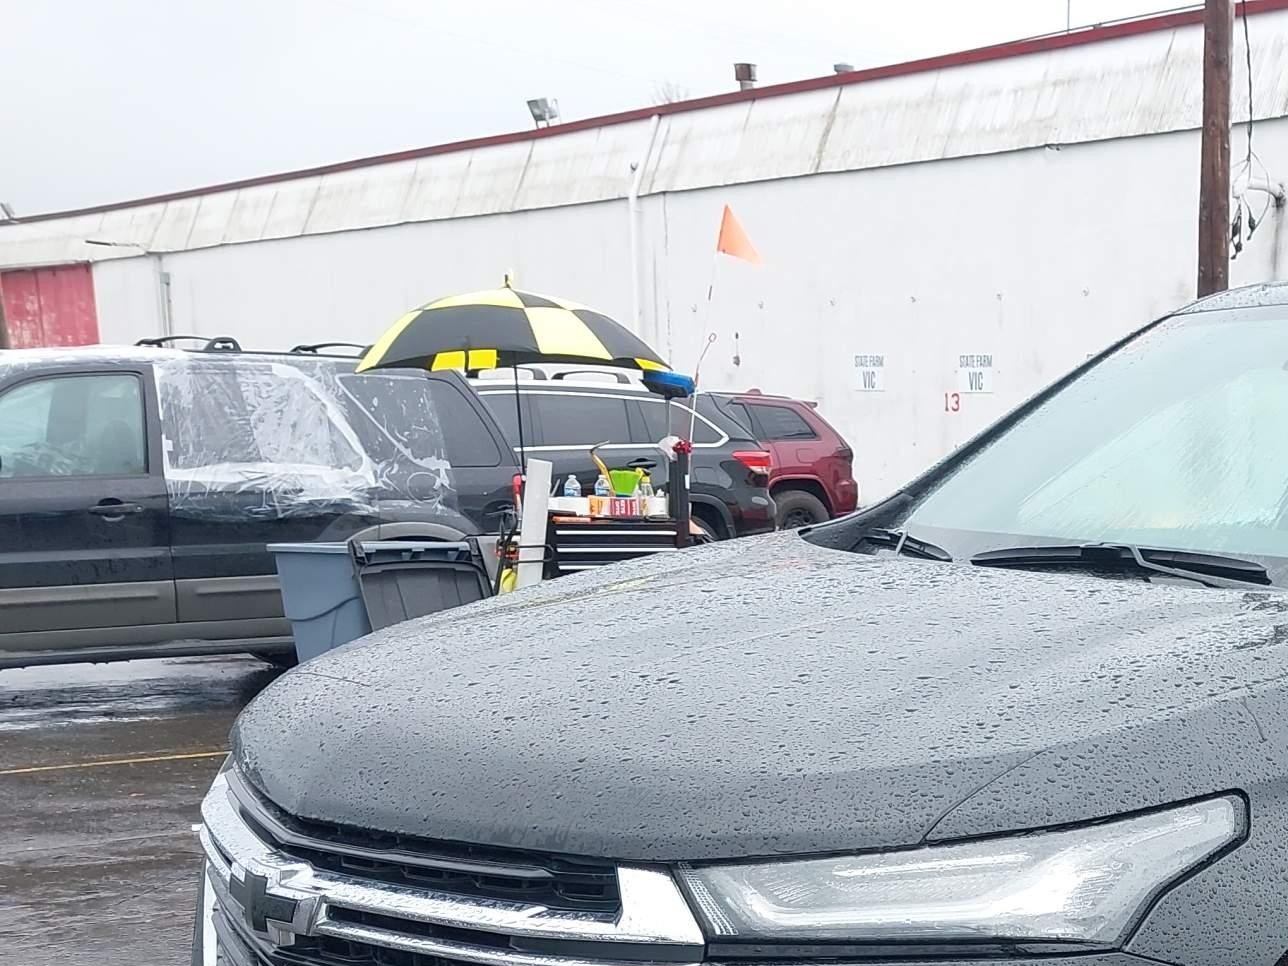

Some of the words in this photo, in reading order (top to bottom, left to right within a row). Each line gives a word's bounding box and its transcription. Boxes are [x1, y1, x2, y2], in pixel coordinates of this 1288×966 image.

[854, 355, 868, 368] STATE
[869, 355, 885, 368] FARM
[959, 355, 976, 368] STATE
[976, 355, 993, 368] FARM
[862, 370, 876, 389] VIC
[968, 371, 984, 391] VIC
[944, 392, 960, 412] 13
